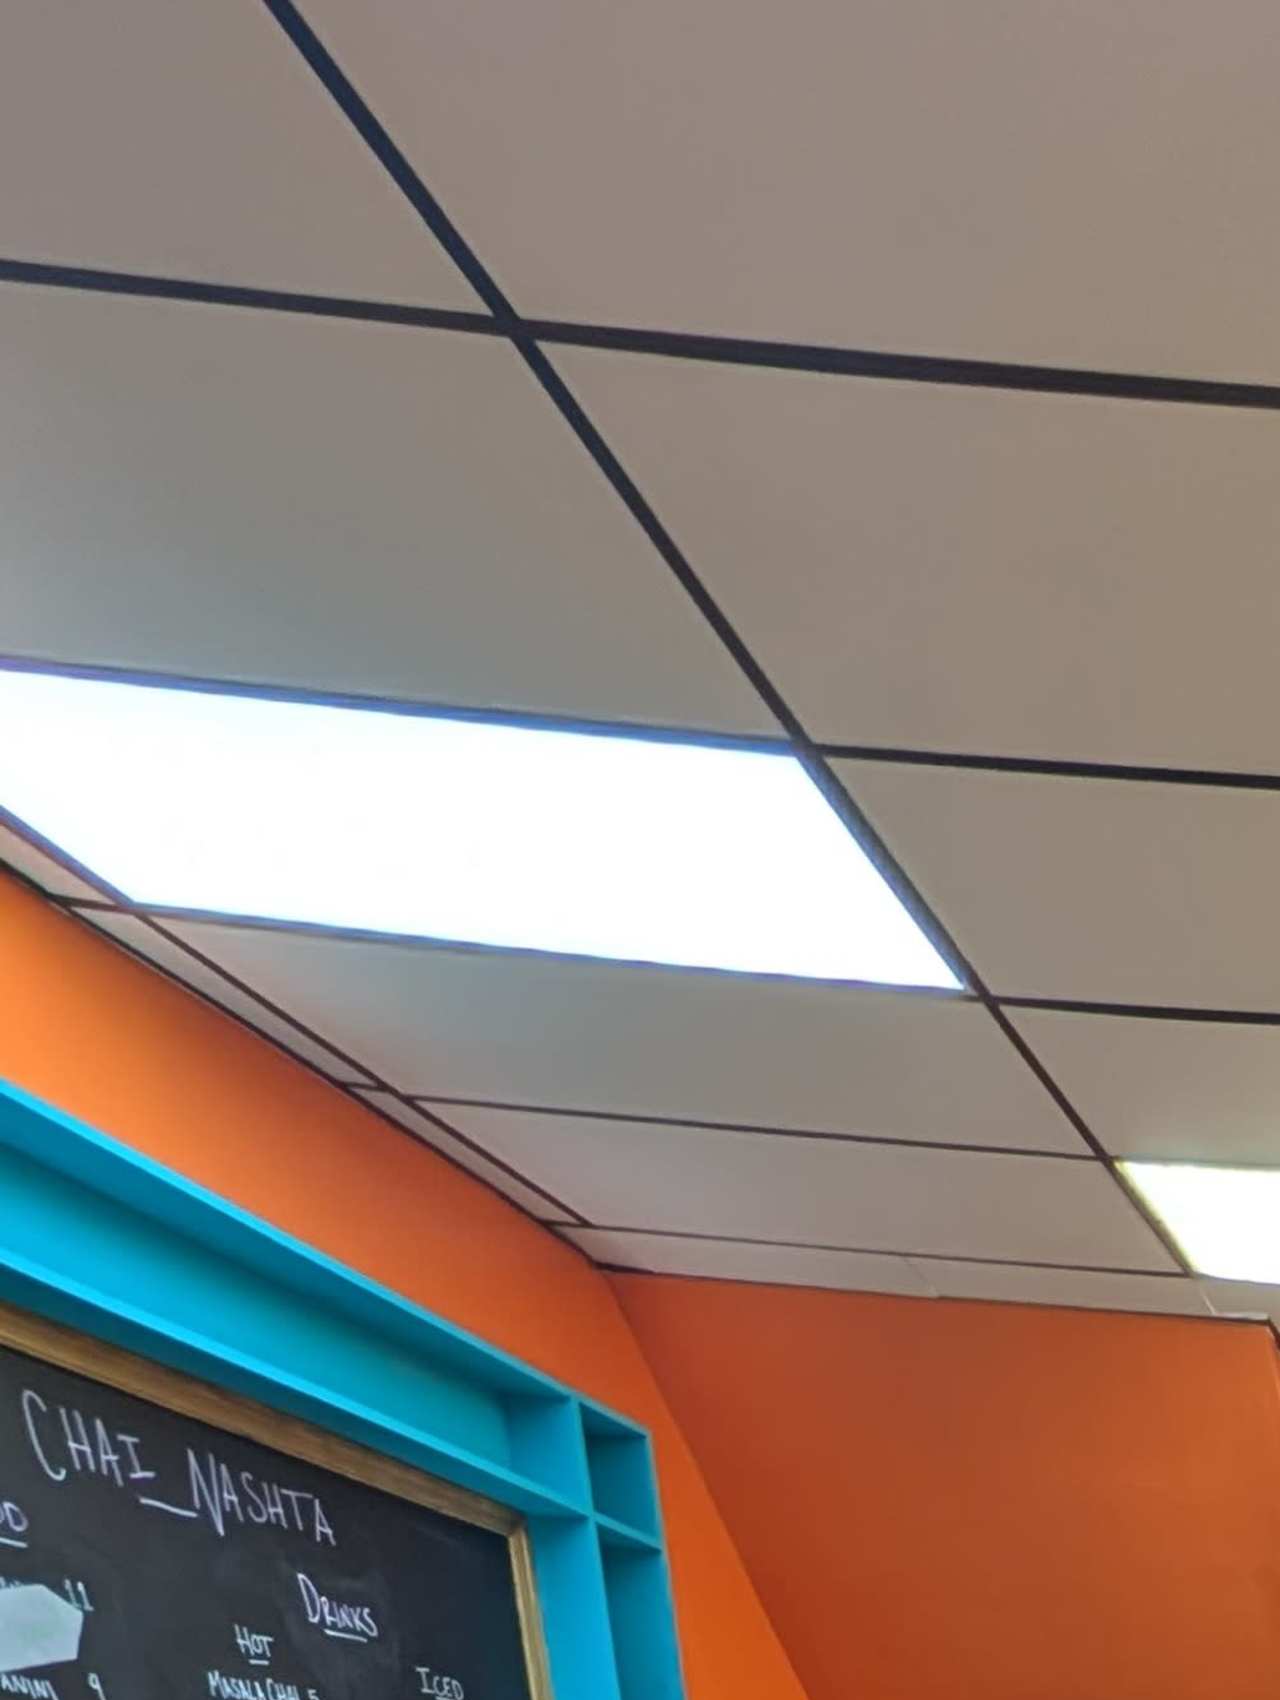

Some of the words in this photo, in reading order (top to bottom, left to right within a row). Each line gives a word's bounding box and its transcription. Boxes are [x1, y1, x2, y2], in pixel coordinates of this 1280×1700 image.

[22, 1389, 155, 1487] CHAI
[187, 1447, 337, 1546] NASHTA
[234, 1624, 274, 1658] HOT
[416, 1666, 464, 1700] ICED
